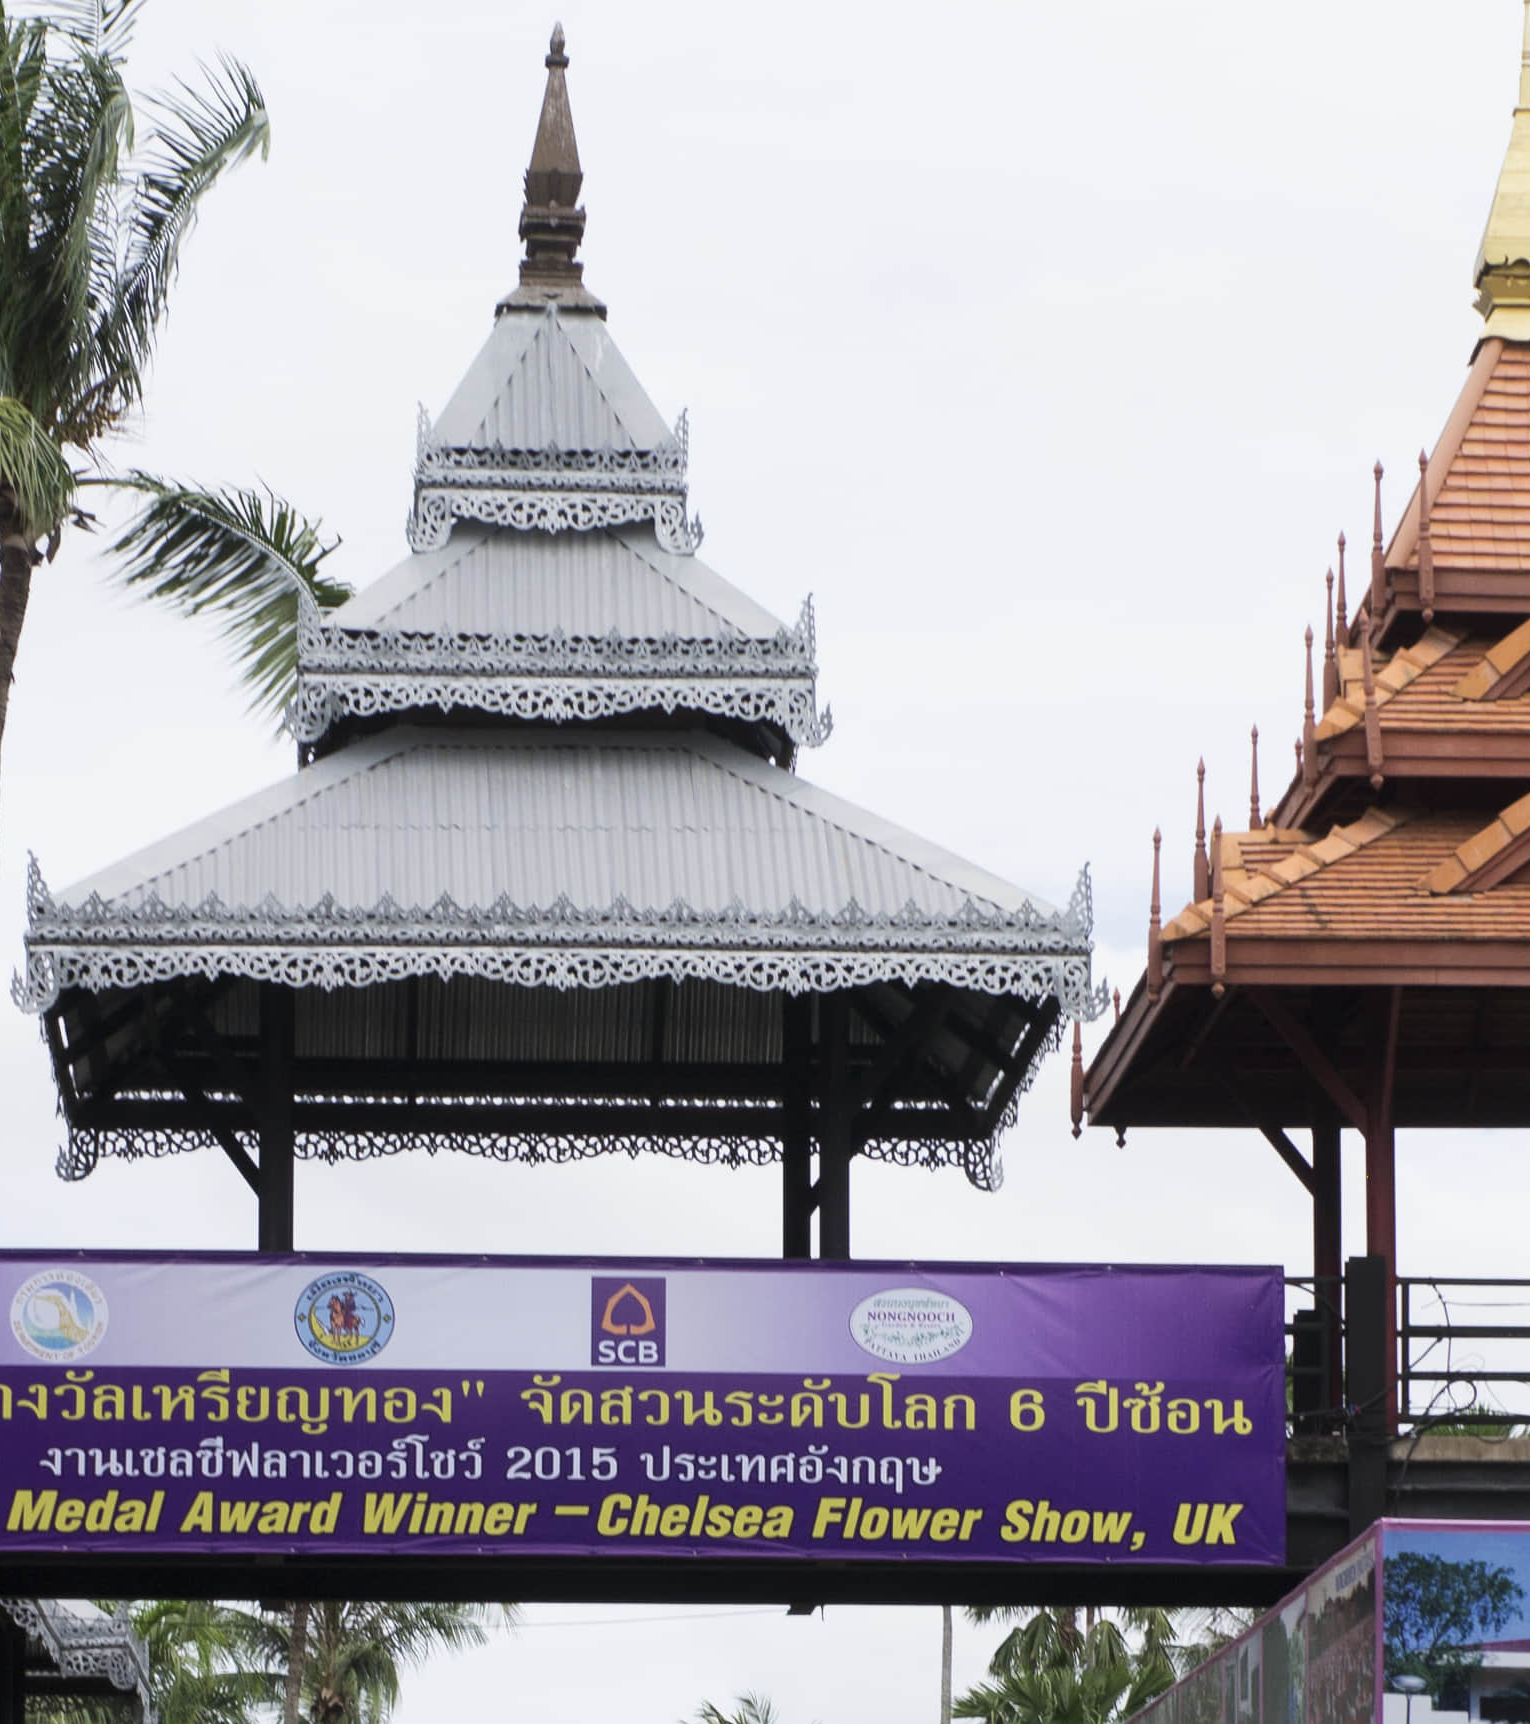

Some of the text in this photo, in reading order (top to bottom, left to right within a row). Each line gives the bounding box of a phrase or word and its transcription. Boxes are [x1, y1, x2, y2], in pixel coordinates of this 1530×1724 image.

[867, 1311, 955, 1323] NONGNOOCH
[598, 1340, 659, 1364] SCB
[520, 1374, 977, 1432] จัดสวนระดับโลก
[1010, 1388, 1046, 1432] 6
[1076, 1380, 1254, 1437] ปีซ้อน
[506, 1445, 619, 1483] 2015
[641, 1445, 943, 1493] ประเทศอังกฤษ
[6, 1489, 163, 1535] Medal
[180, 1491, 339, 1537] Award
[363, 1492, 536, 1539] Winner
[813, 1496, 981, 1543] Flower
[1000, 1498, 1145, 1551] Show,
[1172, 1502, 1245, 1545] UK
